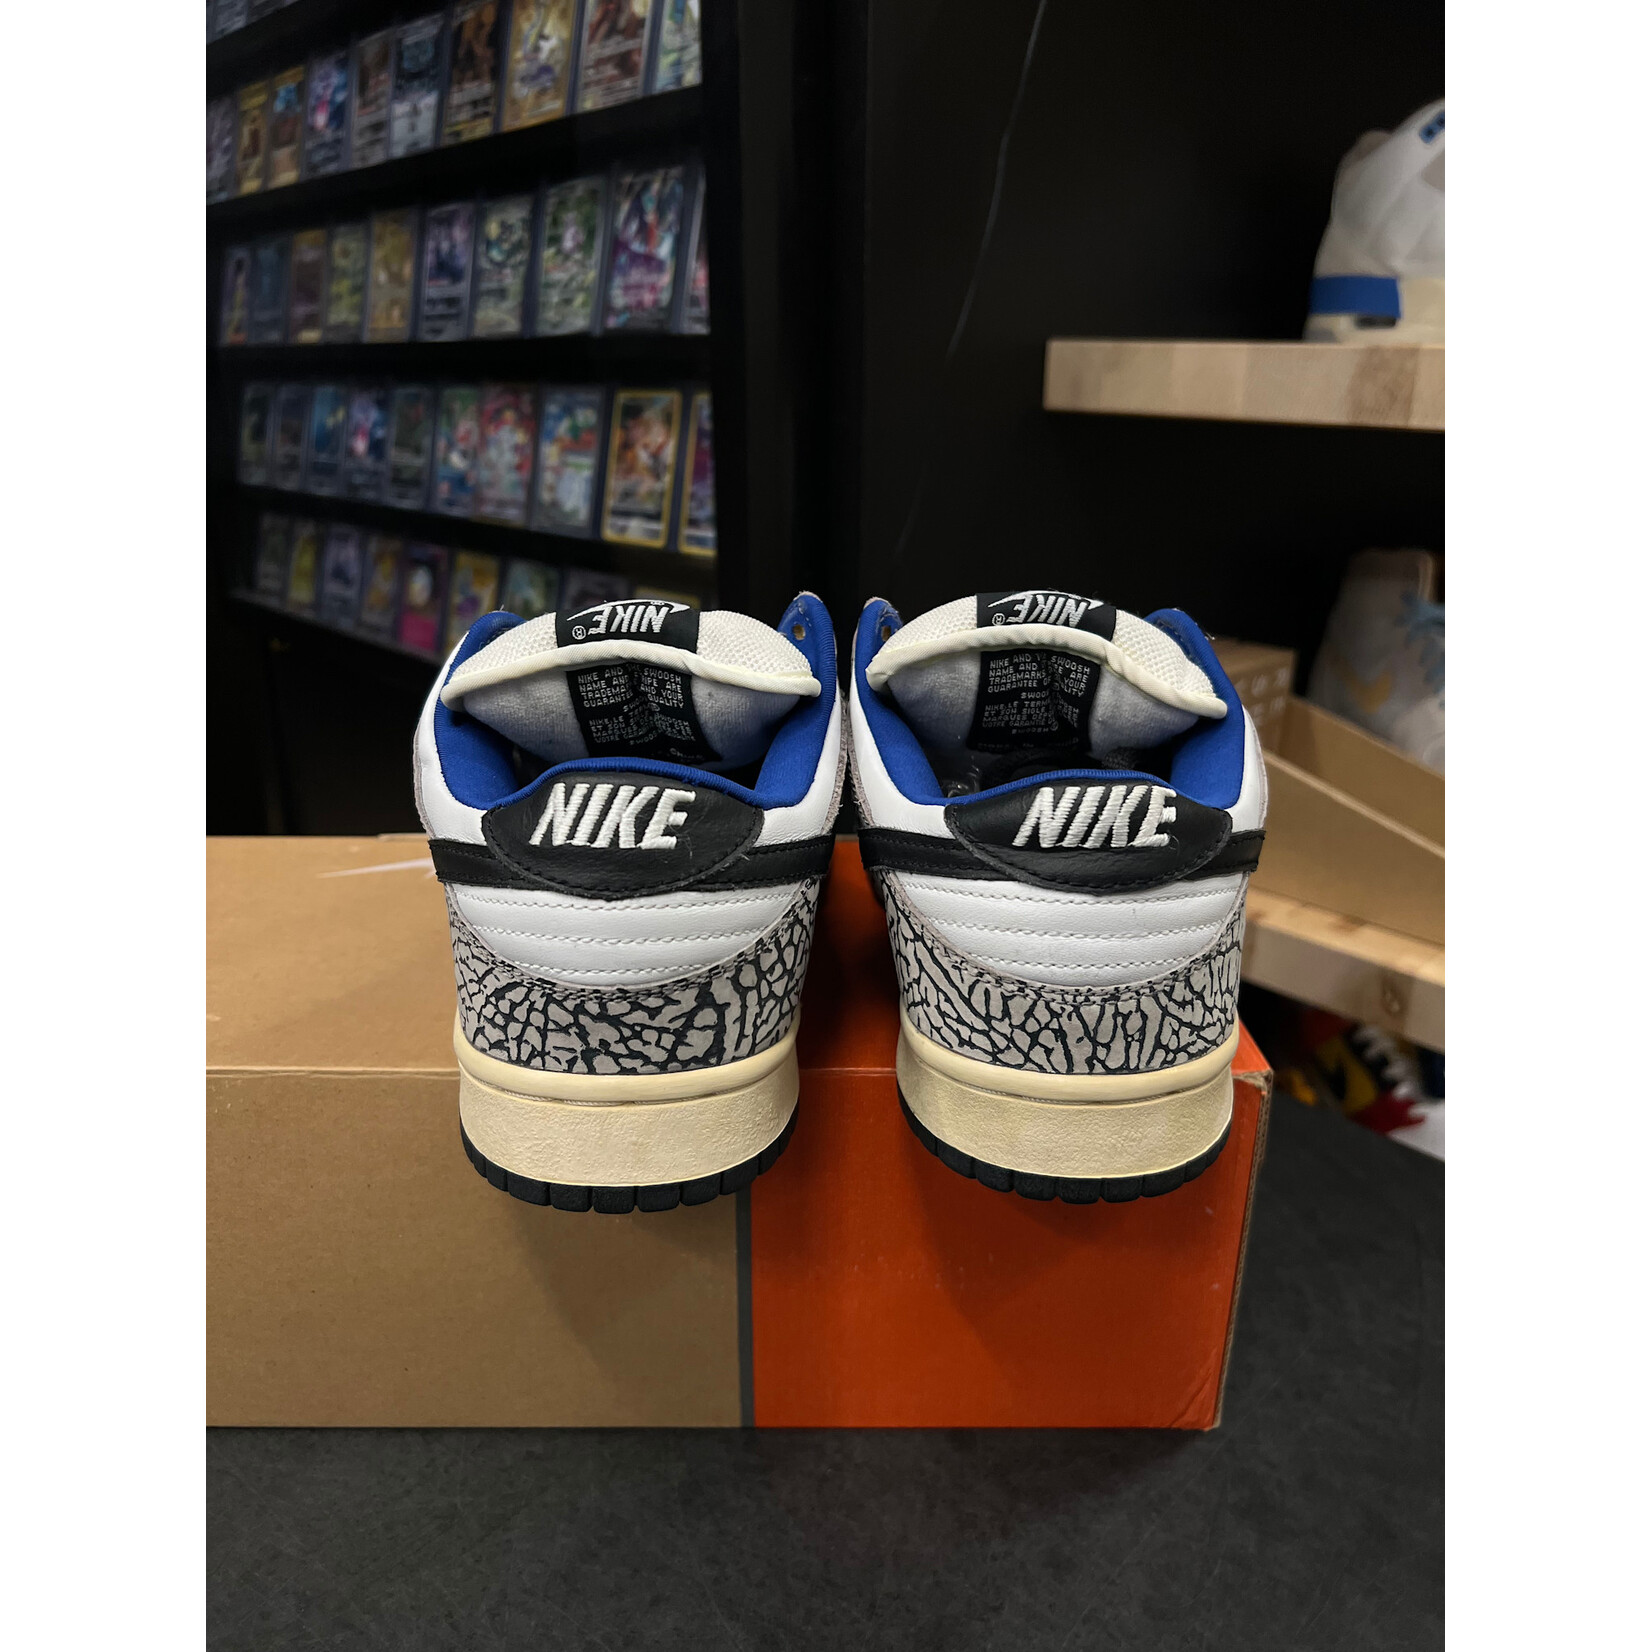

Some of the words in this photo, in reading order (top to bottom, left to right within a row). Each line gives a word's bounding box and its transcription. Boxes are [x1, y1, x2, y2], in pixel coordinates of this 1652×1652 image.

[588, 605, 669, 635] NIKE
[1006, 594, 1088, 628] NIKE
[577, 671, 599, 684] NIKE
[604, 666, 624, 678] AND
[643, 667, 682, 685] SWOOSH
[988, 665, 1014, 678] NAME
[1018, 662, 1039, 672] AND
[1069, 671, 1090, 684] ARE
[989, 658, 1010, 670] NIKE
[1012, 653, 1032, 664] AND
[1050, 655, 1091, 676] SWOOSH
[579, 680, 607, 693] NAME
[665, 681, 683, 693] ARE
[987, 679, 1038, 693] GUARANTEE
[988, 670, 1047, 686] TRADEMARKS
[1063, 677, 1087, 692] YOUR
[640, 683, 657, 695] AND
[661, 689, 684, 702] YOUR
[647, 694, 684, 709] QUALITY
[529, 782, 697, 849] NIKE
[1012, 786, 1177, 849] NIKE
